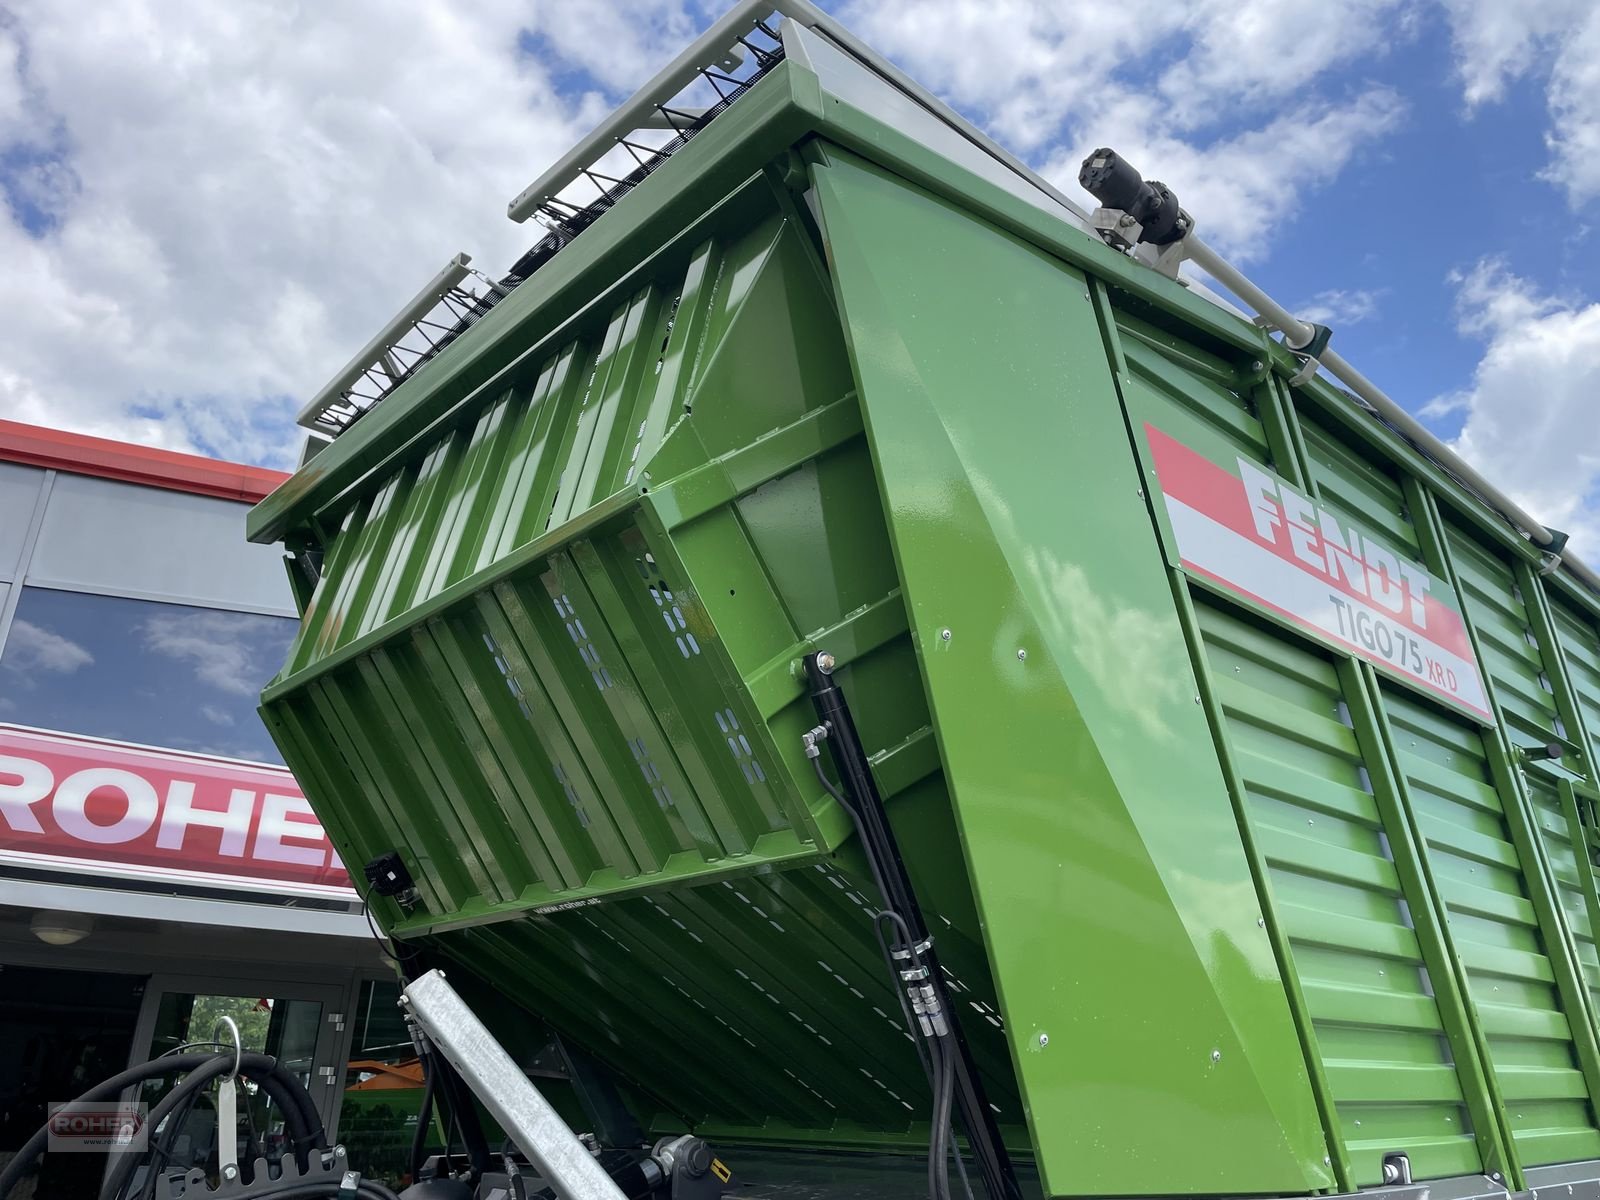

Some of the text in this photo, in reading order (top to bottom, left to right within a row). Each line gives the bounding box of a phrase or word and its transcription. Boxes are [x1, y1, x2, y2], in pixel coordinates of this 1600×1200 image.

[1236, 456, 1431, 630] FENDT
[0, 755, 347, 868] ROHE
[533, 897, 602, 914] www.roher.at
